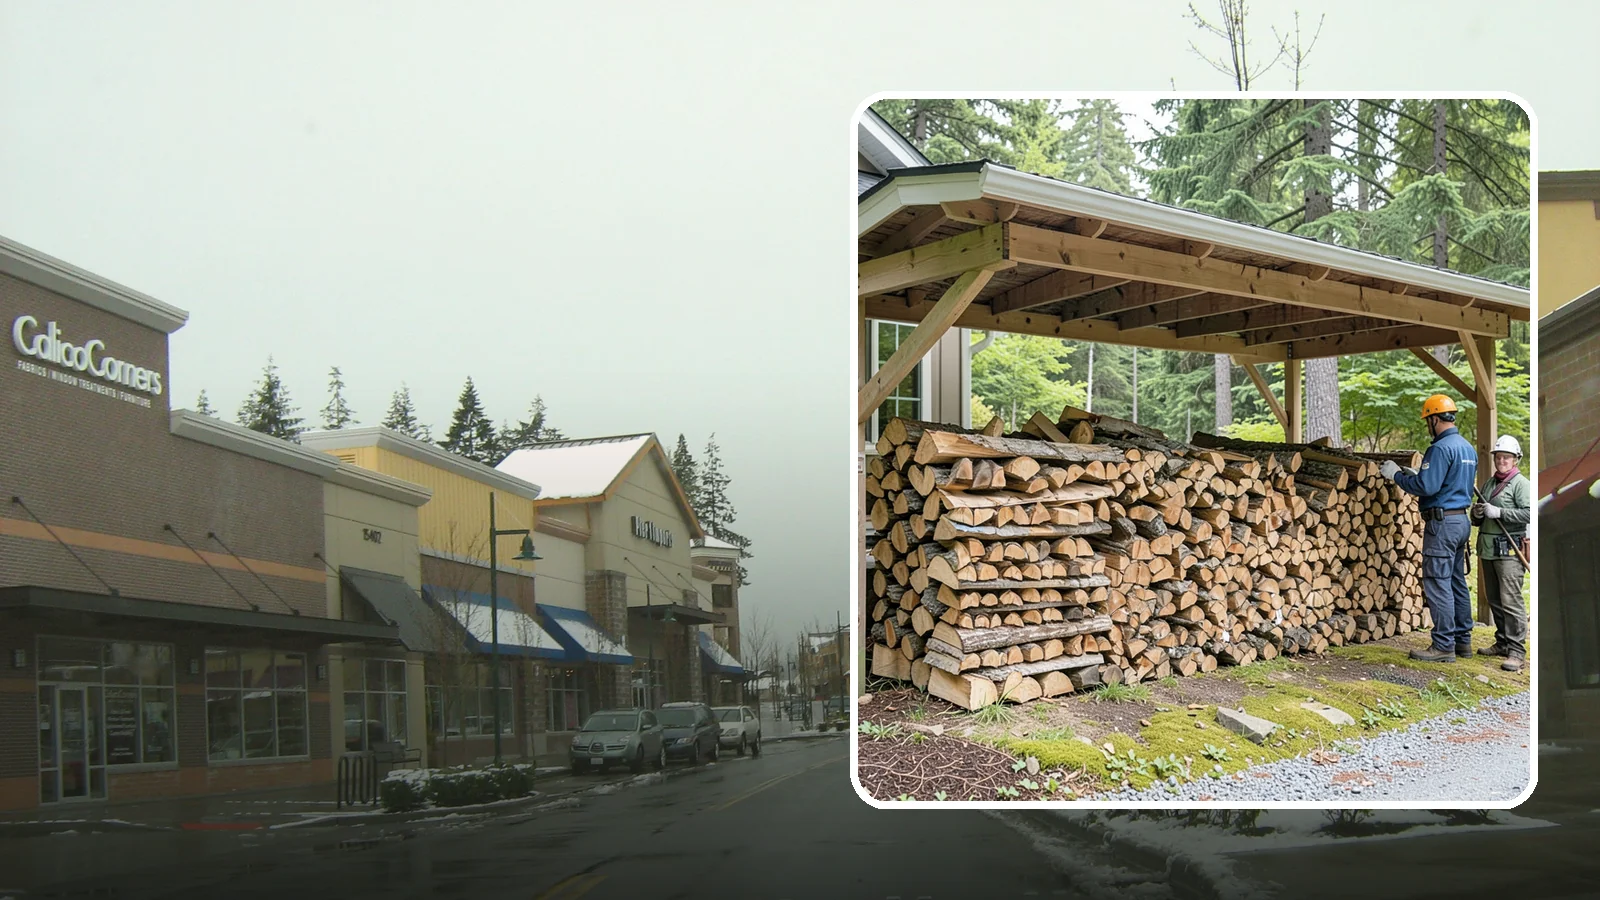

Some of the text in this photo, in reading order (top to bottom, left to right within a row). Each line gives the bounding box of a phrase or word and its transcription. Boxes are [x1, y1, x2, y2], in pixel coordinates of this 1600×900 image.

[17, 360, 151, 408] FABRICS WINDOW TREATMENTS FURNITURE
